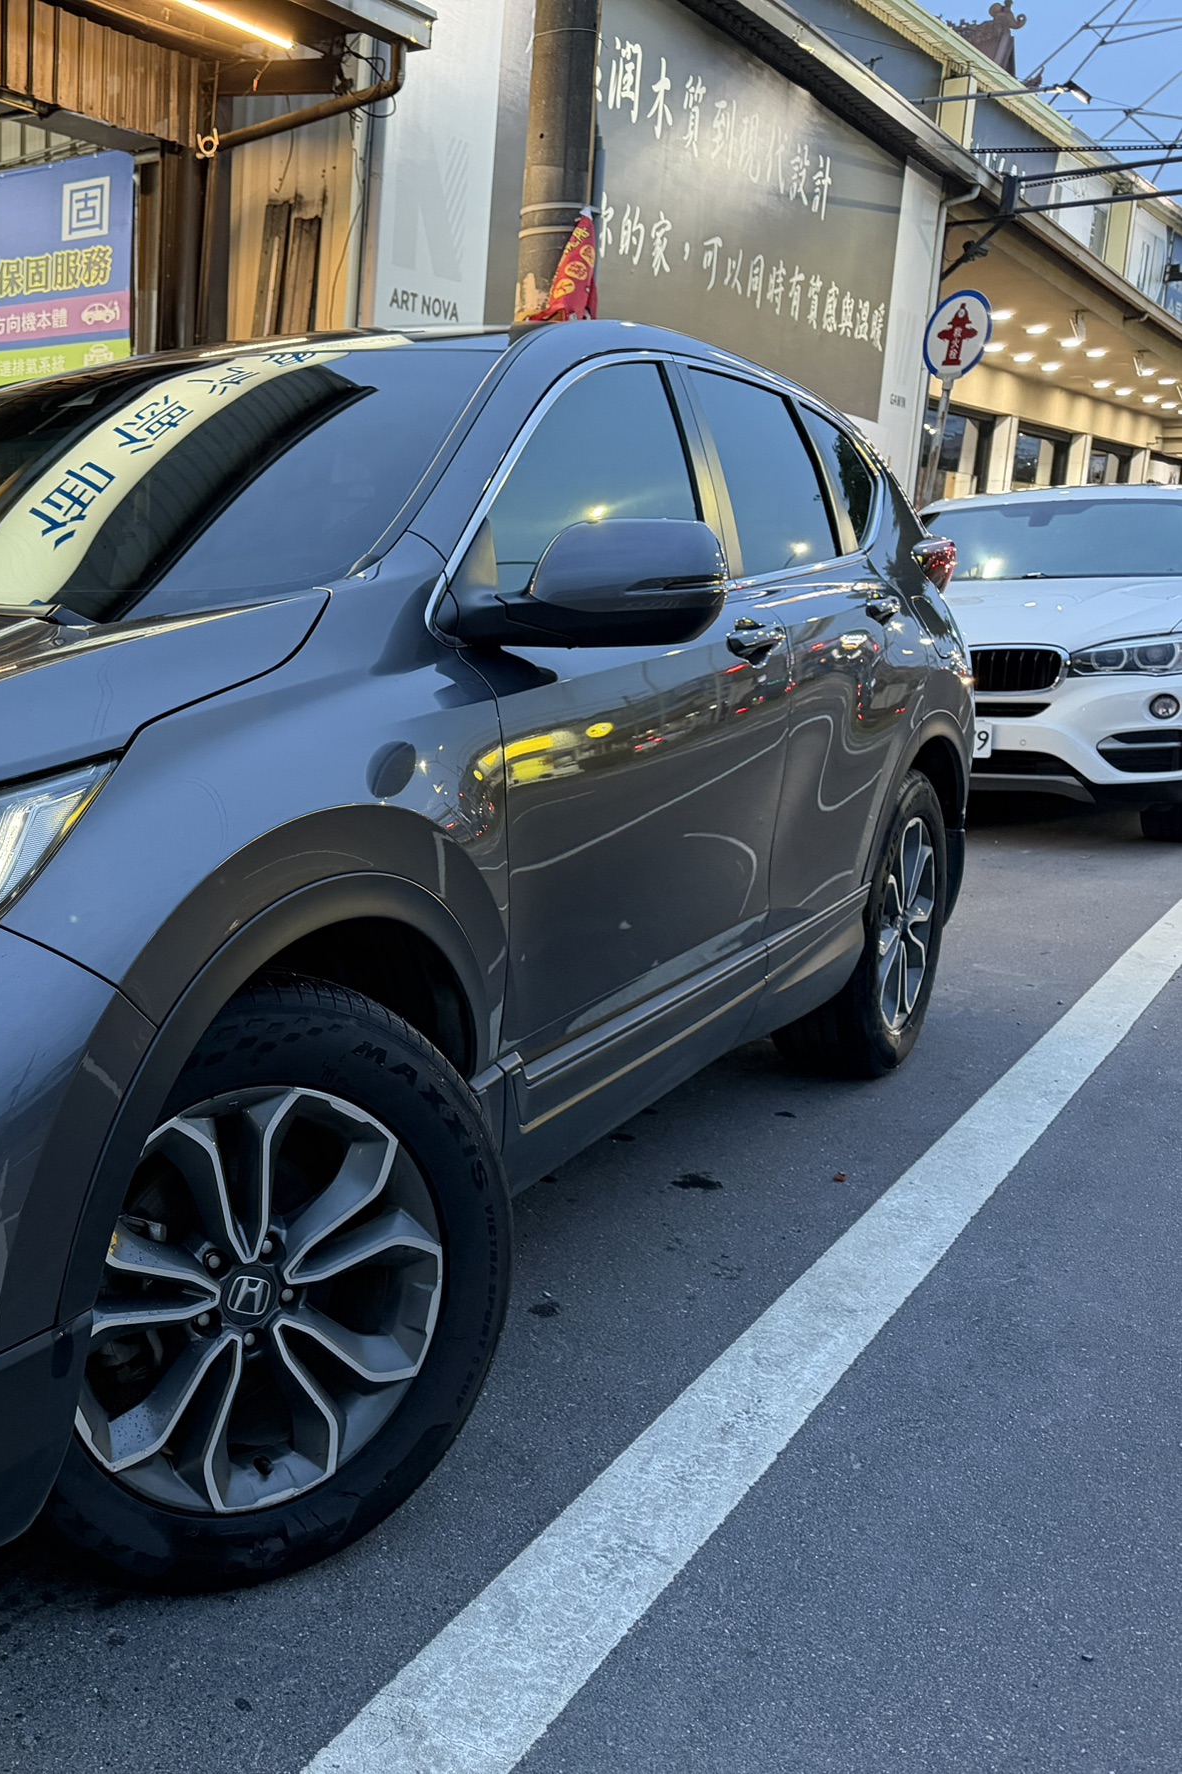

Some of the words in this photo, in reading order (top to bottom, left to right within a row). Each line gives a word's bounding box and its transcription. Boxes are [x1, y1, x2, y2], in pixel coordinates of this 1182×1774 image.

[389, 288, 418, 313] ART
[421, 294, 459, 322] NOVA
[350, 1040, 489, 1192] MAXXIS
